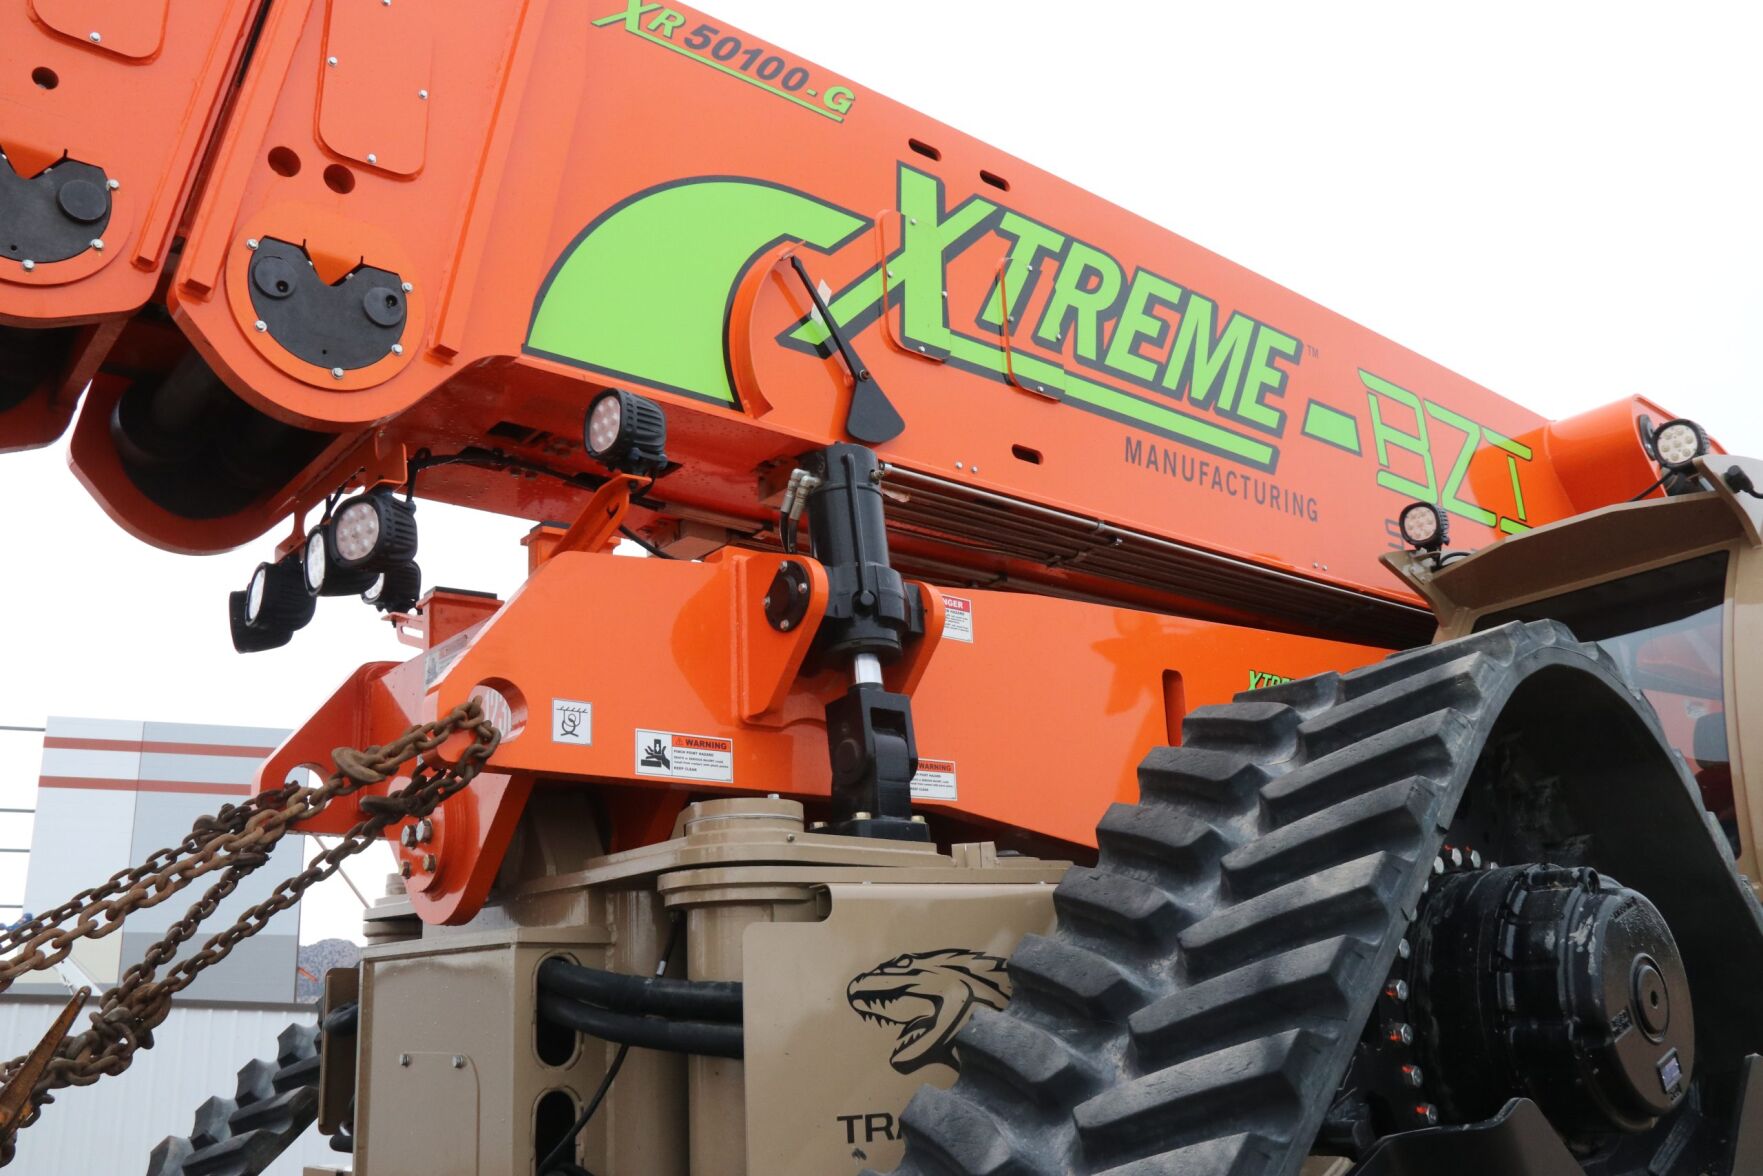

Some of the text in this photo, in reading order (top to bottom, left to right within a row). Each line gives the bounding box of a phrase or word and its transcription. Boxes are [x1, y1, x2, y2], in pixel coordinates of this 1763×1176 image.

[591, 0, 687, 39] XR
[776, 160, 1304, 438] XTREME
[1124, 435, 1320, 522] MANUFACTURING
[943, 597, 964, 609] NGER
[685, 738, 727, 750] WARNING
[918, 762, 952, 772] WARNING
